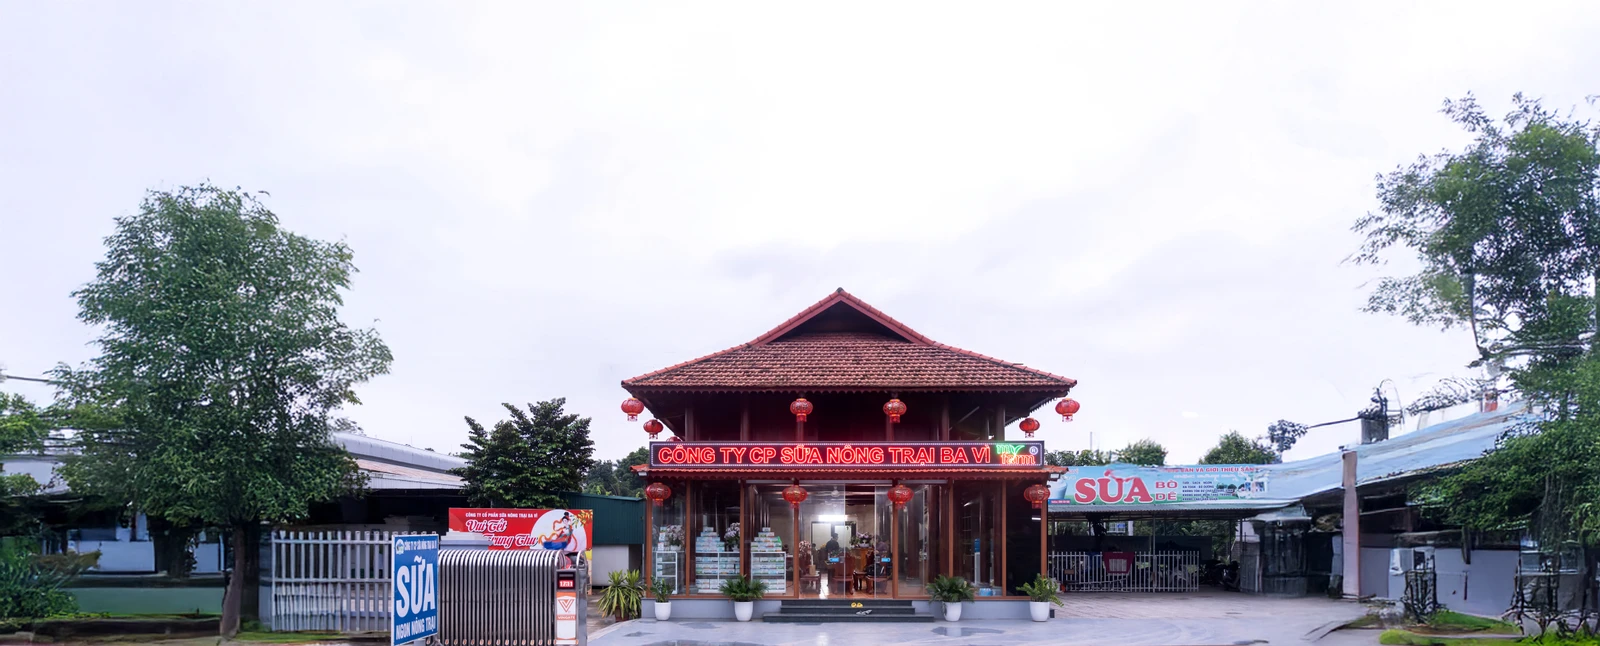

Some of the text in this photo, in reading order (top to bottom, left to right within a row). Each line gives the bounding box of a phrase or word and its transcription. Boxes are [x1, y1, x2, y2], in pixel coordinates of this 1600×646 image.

[658, 444, 991, 466] CÔNG TY CP SỮA NÔNG TRẠI BA VÌ
[1155, 480, 1178, 489] BÒ
[1155, 492, 1177, 501] DÊ
[466, 518, 508, 532] Vui Tết
[515, 533, 538, 547] Thu
[396, 555, 436, 618] SỮA
[396, 616, 436, 640] NGON NÔNG TRẠI
